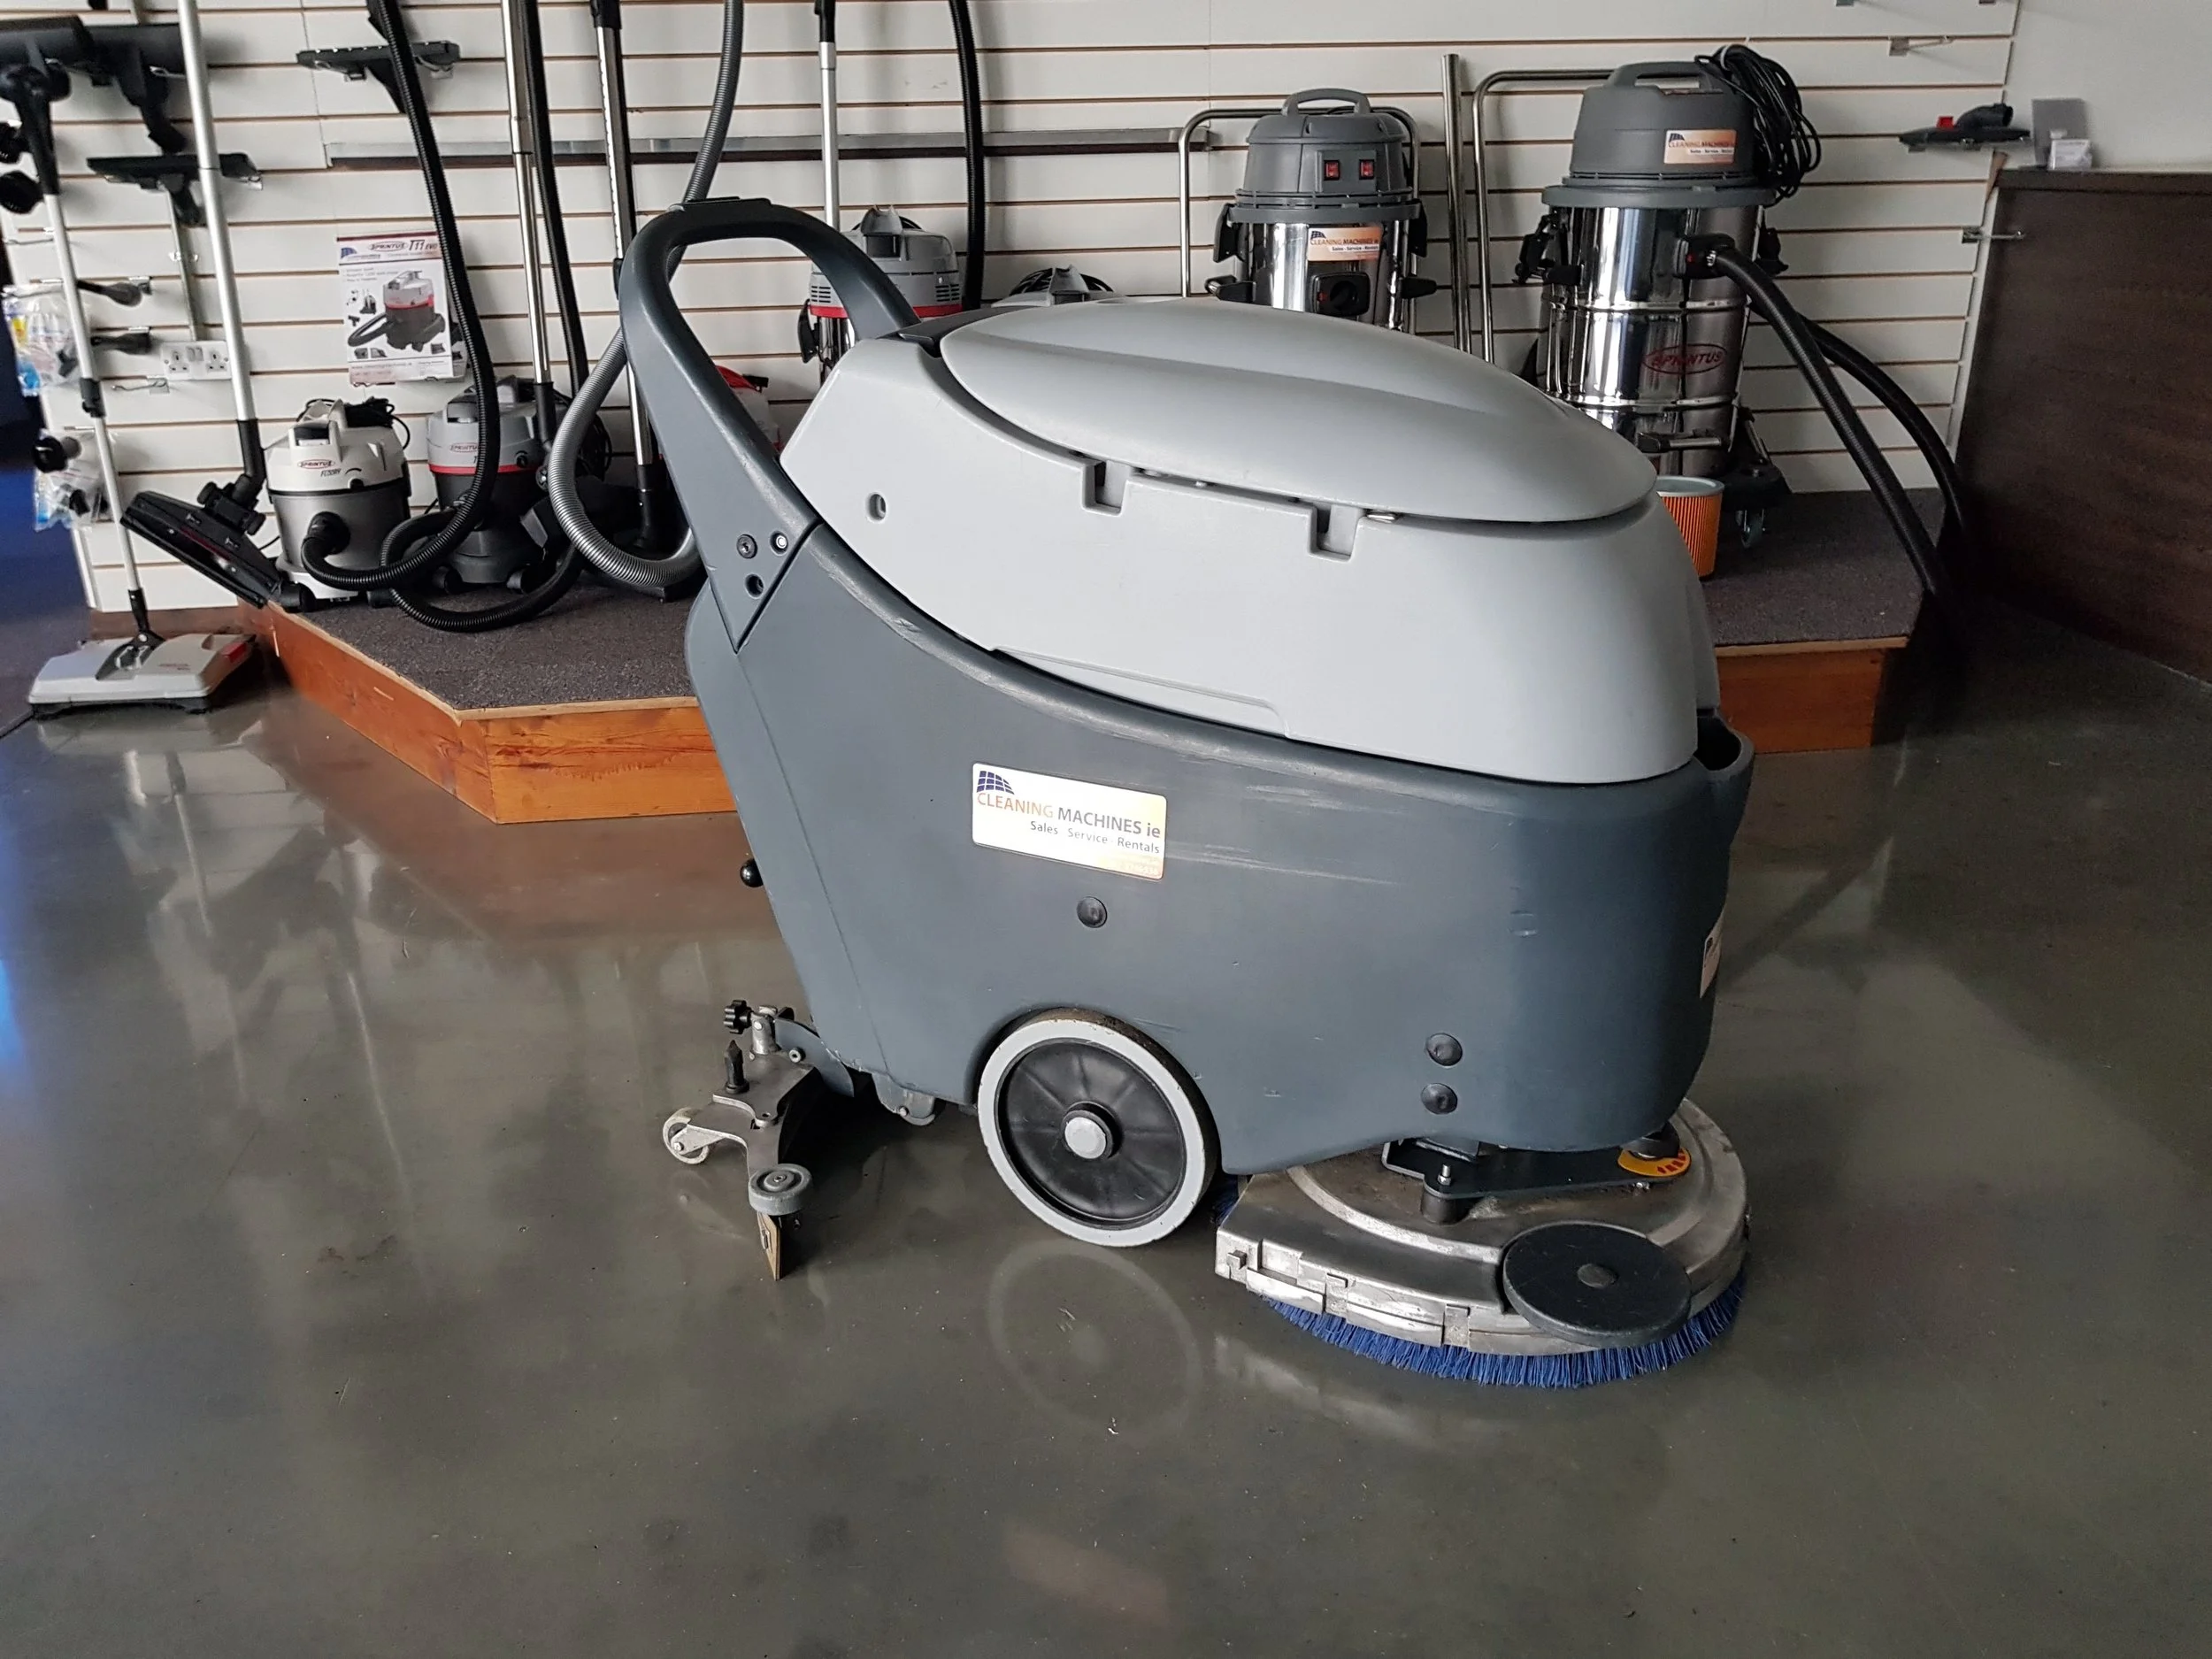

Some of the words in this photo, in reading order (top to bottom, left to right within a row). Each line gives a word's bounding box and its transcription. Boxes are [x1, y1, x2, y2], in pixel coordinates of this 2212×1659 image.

[977, 792, 1054, 818] CLEANING
[1057, 807, 1141, 834] MACHINES
[1030, 820, 1059, 835] Sales
[1067, 827, 1108, 844] Service
[1118, 836, 1161, 855] Rentals
